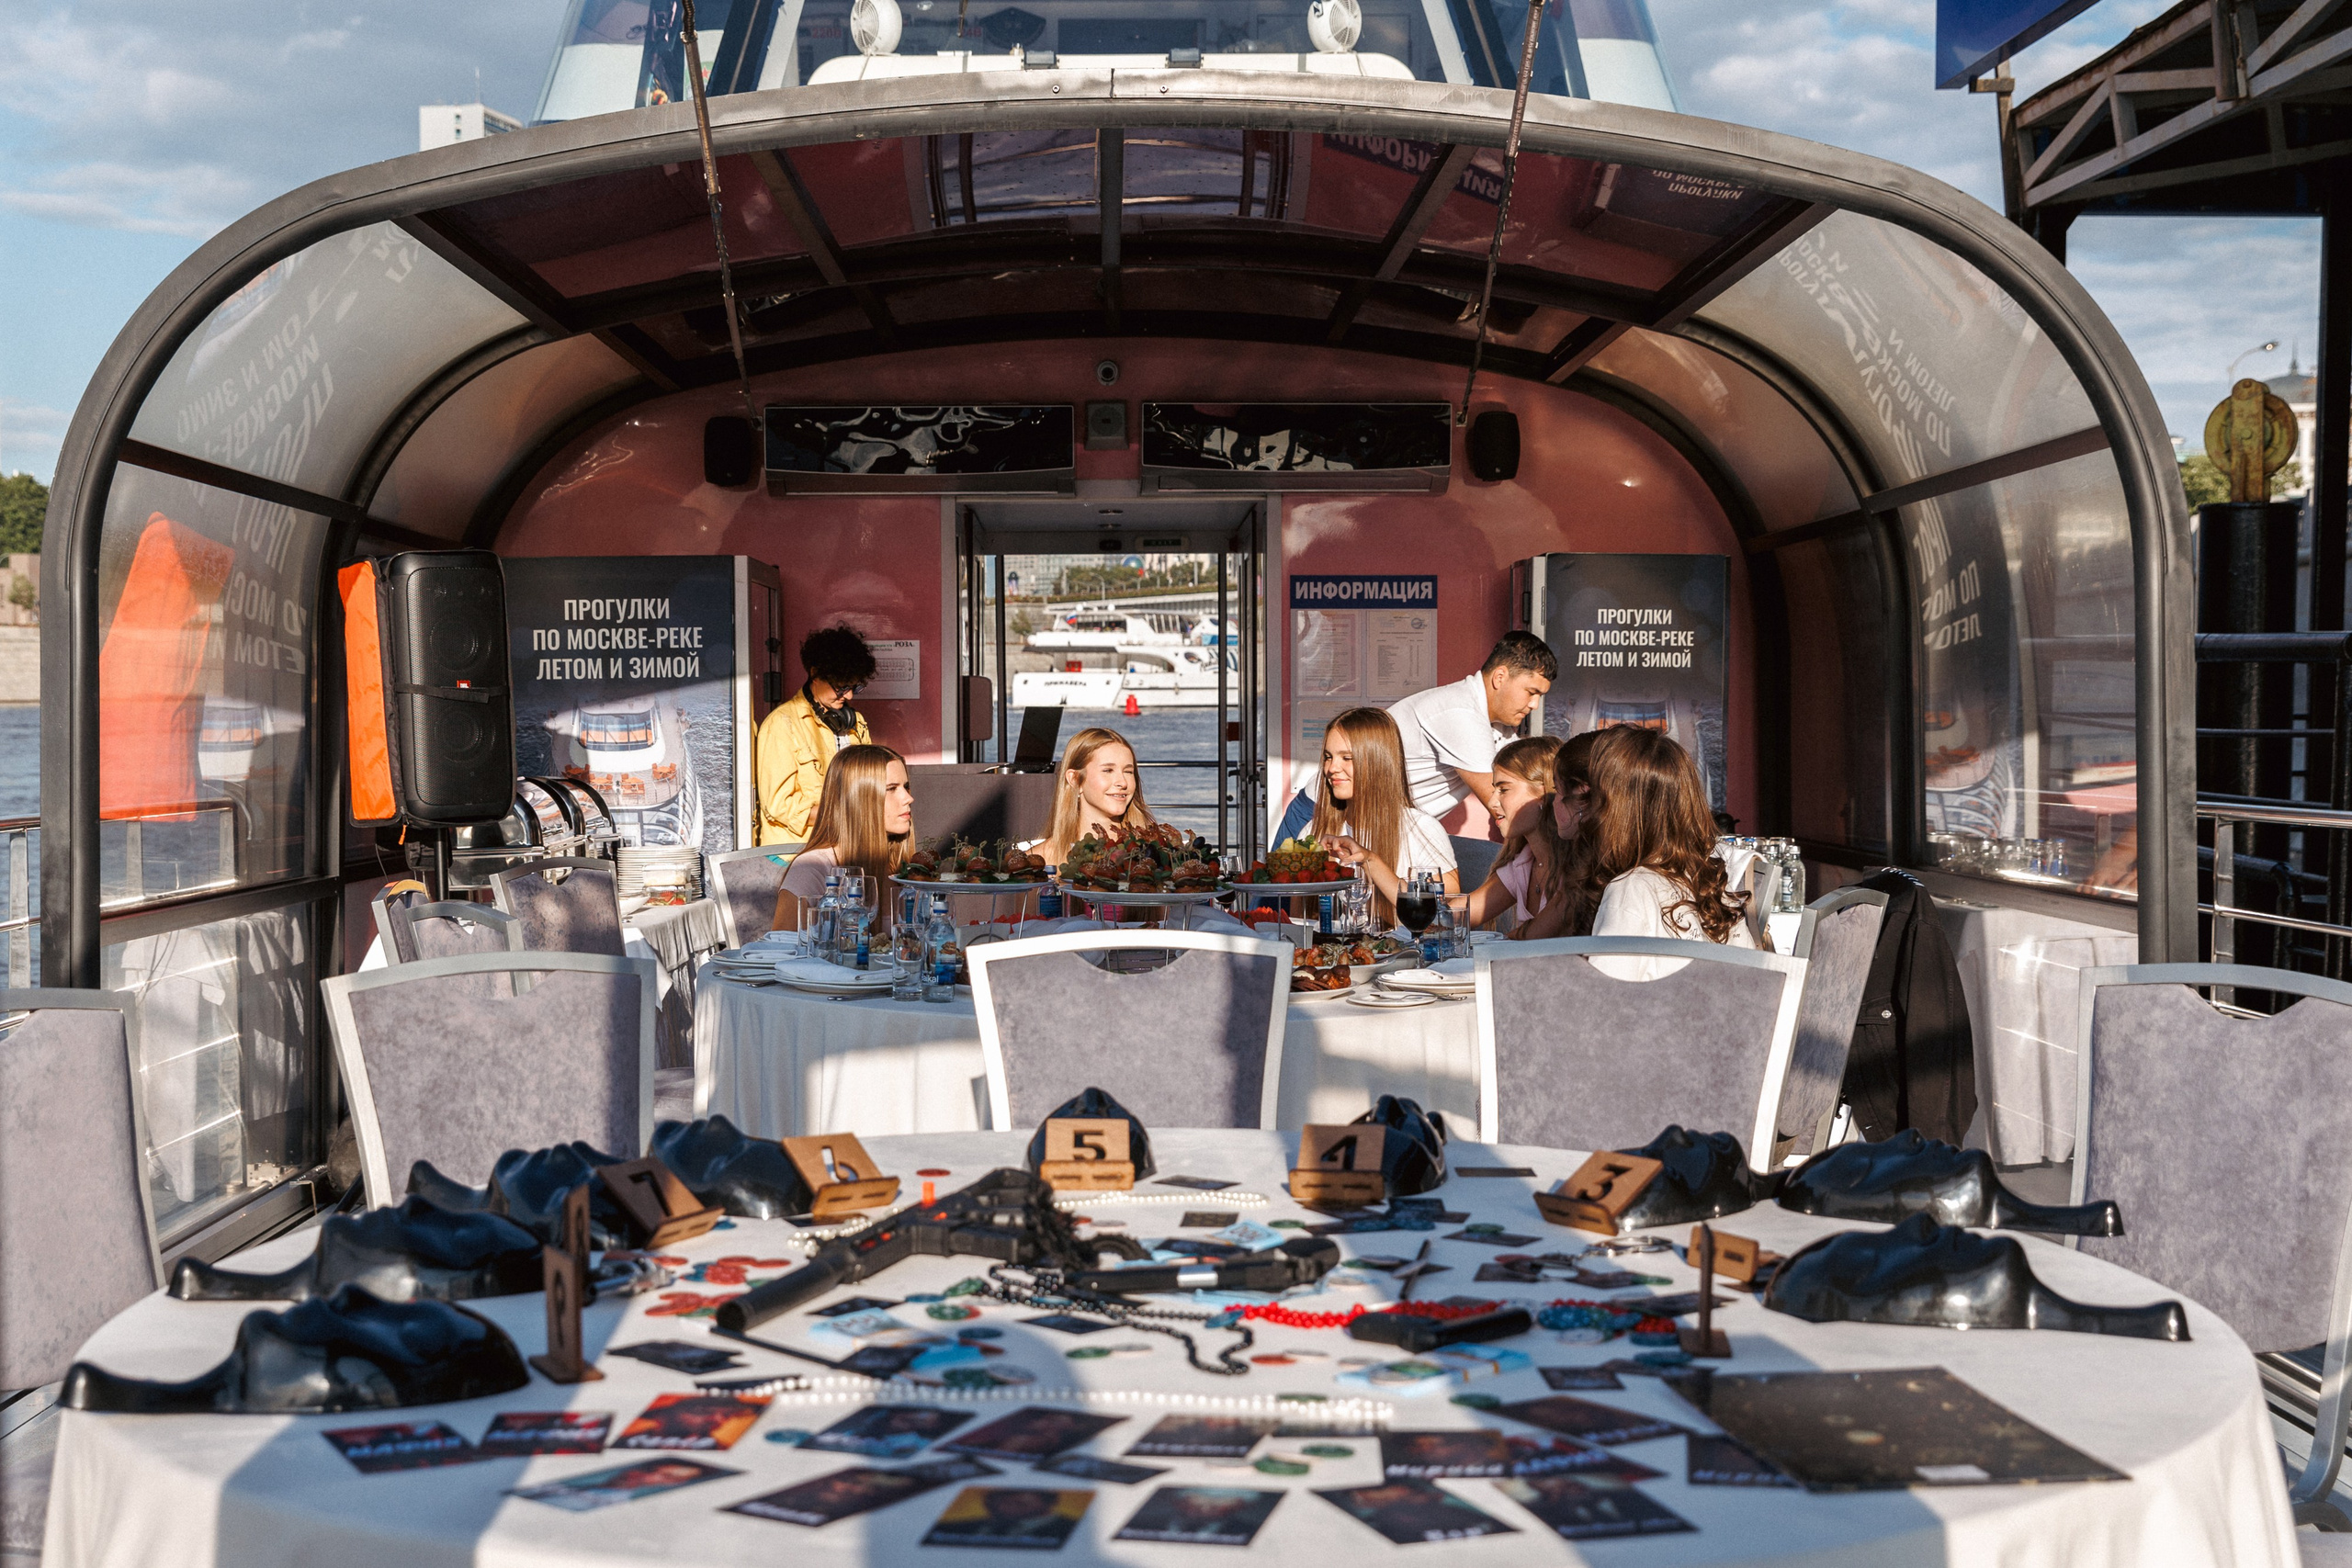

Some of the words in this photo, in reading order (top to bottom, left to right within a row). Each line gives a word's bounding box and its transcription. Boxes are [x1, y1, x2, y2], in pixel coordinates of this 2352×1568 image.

[1295, 581, 1432, 603] ИНФОРМАЦИЯ
[564, 598, 670, 623] ПРОГУЛКИ
[1598, 609, 1672, 626] ПРОГУЛКИ
[533, 629, 560, 650] ПО
[567, 627, 703, 650] МОСКВЕ-РЕКЕ
[1575, 630, 1594, 645] ПО
[1599, 630, 1694, 646] МОСКВЕ-РЕКЕ
[537, 658, 603, 680] ЛЕТОМ
[610, 658, 623, 679] И
[629, 651, 699, 679] ЗИМОЙ
[1577, 651, 1623, 667] ЛЕТОМ
[1628, 652, 1637, 667] И
[1642, 649, 1691, 668] ЗИМОЙ
[1073, 1129, 1106, 1160] 5
[1321, 1134, 1357, 1170] 4
[629, 1169, 673, 1217] 7
[1577, 1164, 1634, 1201] 3
